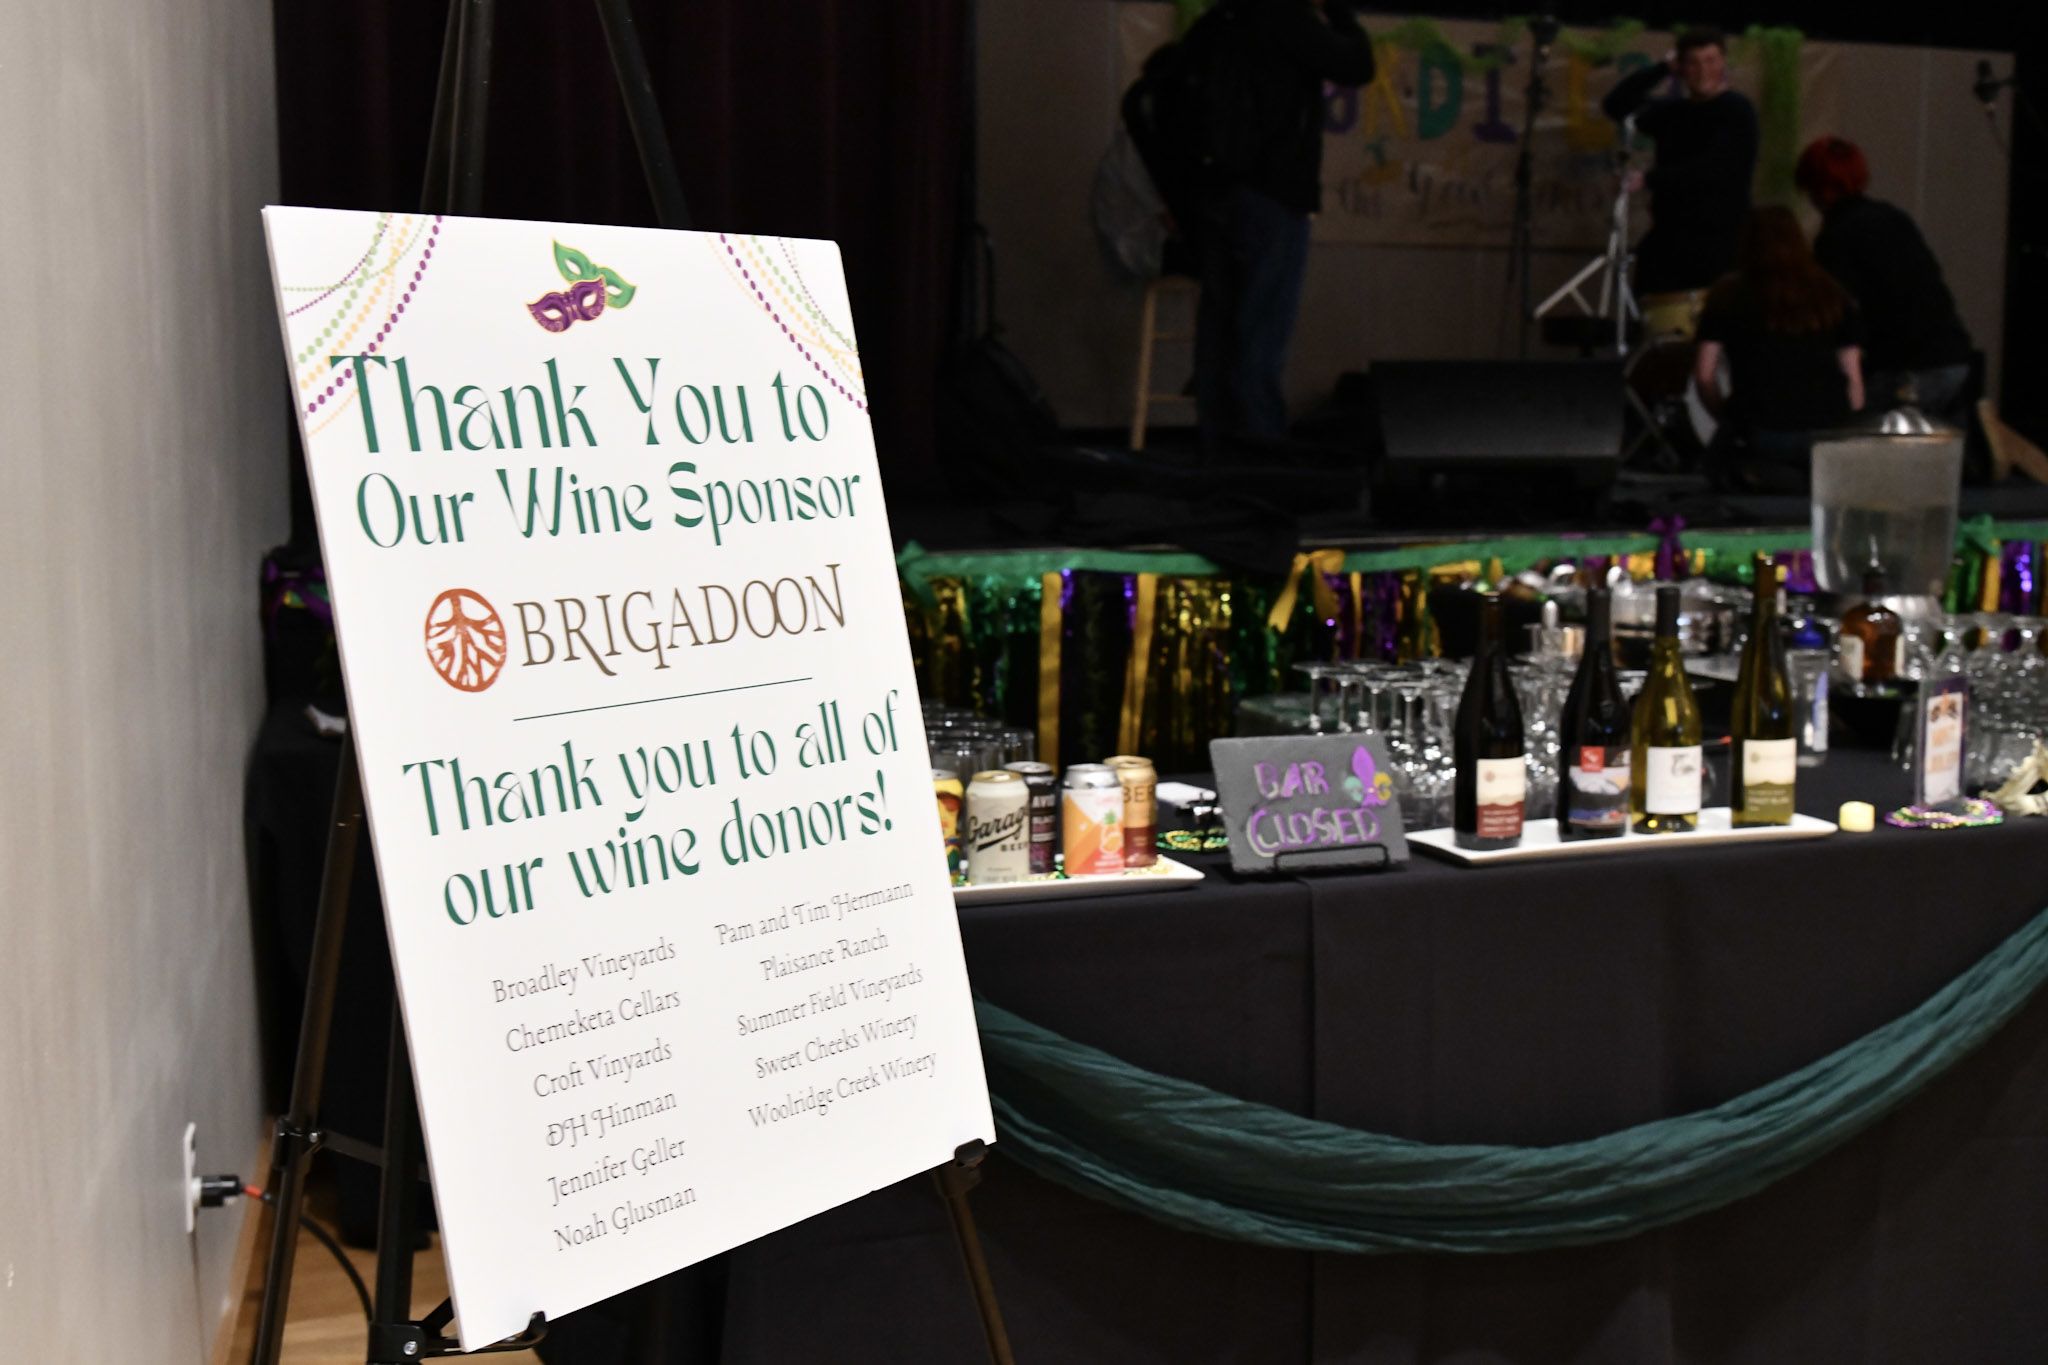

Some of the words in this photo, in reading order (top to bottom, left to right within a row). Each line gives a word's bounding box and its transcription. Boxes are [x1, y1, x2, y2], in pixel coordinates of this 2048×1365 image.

[330, 354, 597, 454] Thank
[614, 357, 753, 447] You
[772, 371, 829, 441] to
[356, 473, 474, 548] Our
[496, 467, 653, 537] Wine
[669, 461, 860, 546] Sponsor
[513, 563, 847, 676] BRIGADOON
[402, 740, 603, 836] Thank
[620, 739, 717, 822] you
[731, 723, 777, 779] to
[795, 699, 847, 768] all
[863, 689, 901, 757] of
[1254, 761, 1329, 798] BAR
[444, 857, 544, 926] our
[568, 827, 700, 899] wine
[720, 769, 893, 867] donors!
[967, 806, 1024, 844] Garag
[1246, 808, 1381, 858] CLOSED
[714, 921, 755, 946] Pam
[759, 906, 790, 936] and
[792, 902, 829, 926] Tim
[832, 882, 914, 921] Herrmann
[493, 963, 579, 1003] Broadley
[582, 936, 677, 980] Vineyards
[759, 946, 834, 981] Plaisance
[837, 927, 889, 960] Ranch
[506, 1007, 615, 1052] Chemeketa
[619, 988, 681, 1023] Cellars
[736, 1001, 806, 1036] Summer
[809, 984, 847, 1015] Field
[849, 963, 924, 1002] Vineyards
[533, 1061, 584, 1097] Croft
[587, 1037, 673, 1083] Vinyards
[755, 1050, 802, 1079] Sweet
[804, 1029, 860, 1063] Cheeks
[861, 1012, 918, 1043] Winery
[591, 1090, 678, 1138] Hinman
[748, 1086, 834, 1128] Woolridge
[836, 1067, 881, 1099] Creek
[880, 1051, 936, 1082] Winery
[546, 1155, 628, 1207] Jennifer
[631, 1137, 687, 1177] Geller
[553, 1212, 608, 1252] Noah
[612, 1185, 697, 1235] Glusman
